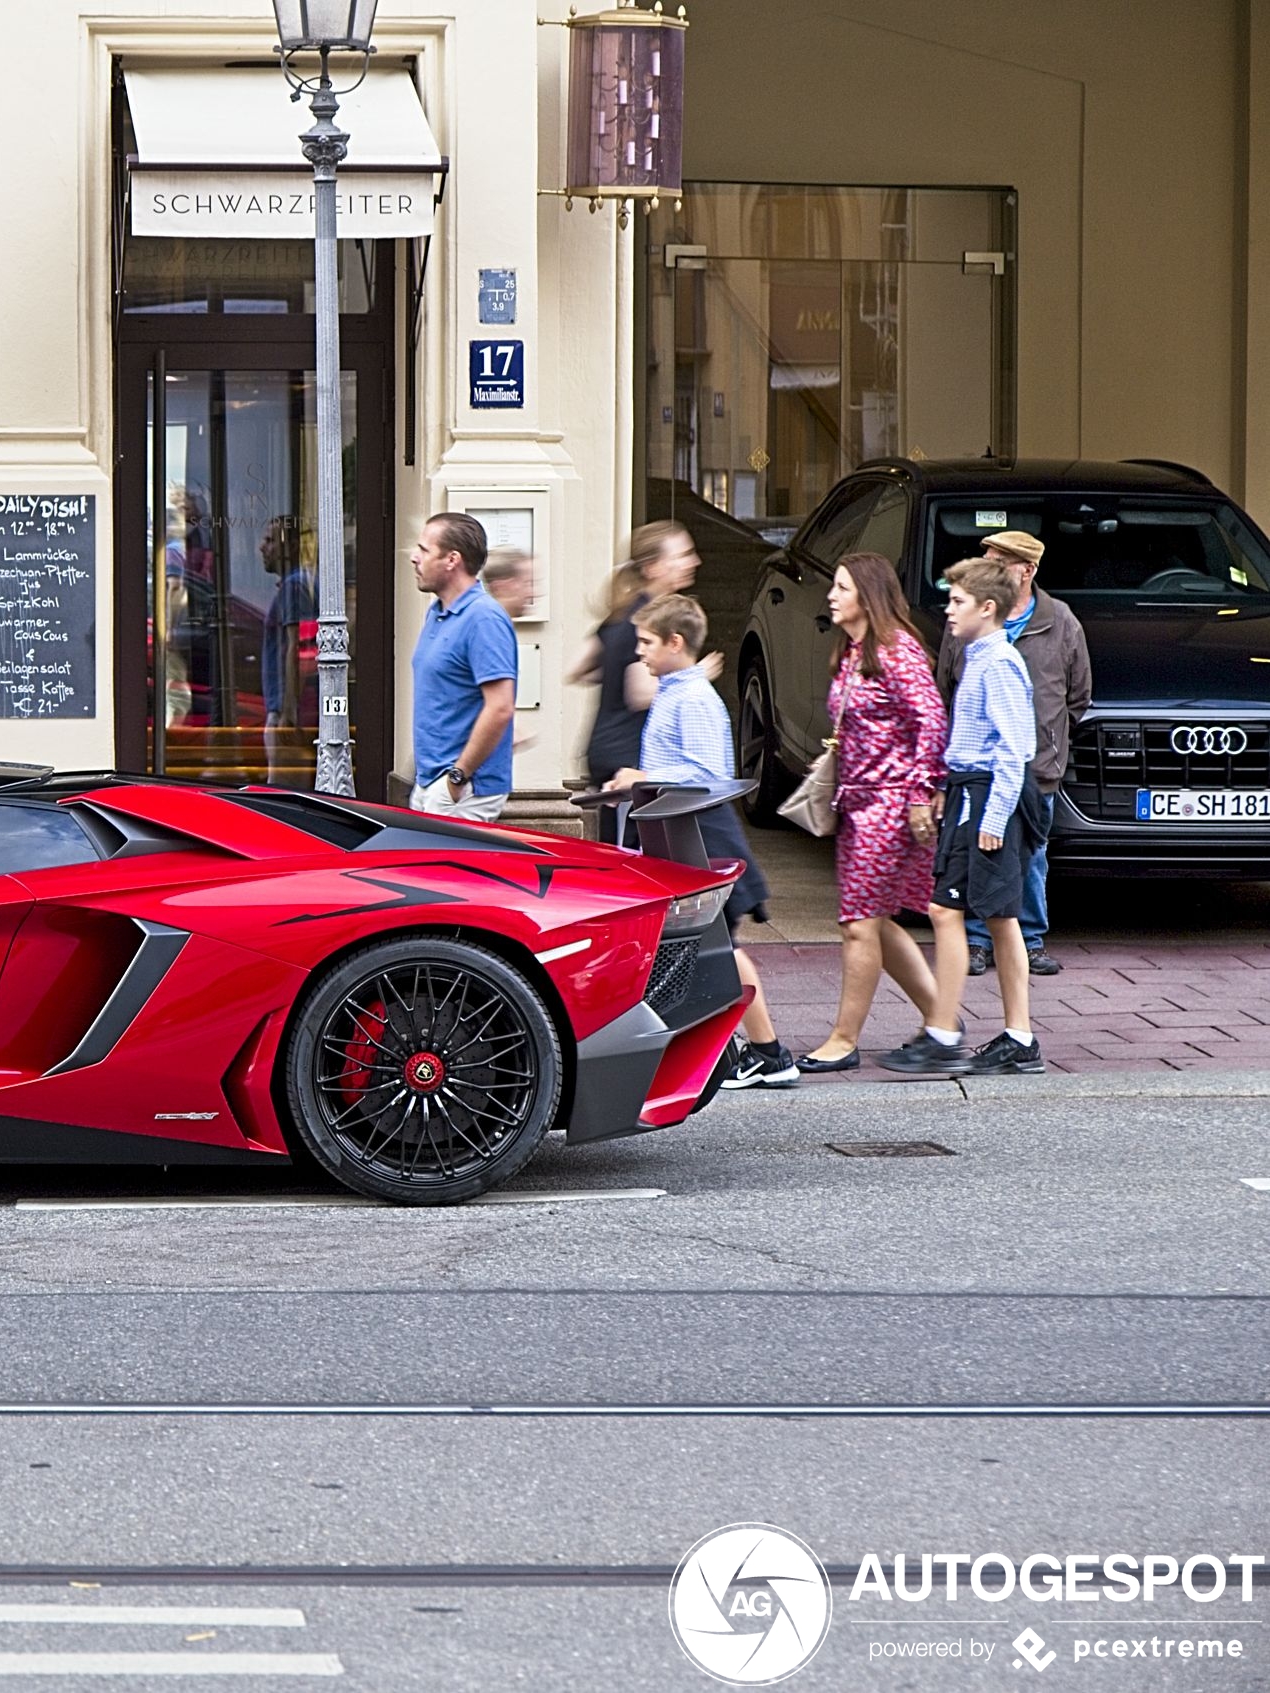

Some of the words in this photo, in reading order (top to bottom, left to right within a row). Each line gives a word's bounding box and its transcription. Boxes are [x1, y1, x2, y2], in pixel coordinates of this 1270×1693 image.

[505, 280, 515, 289] 25
[479, 345, 515, 377] 17
[473, 387, 521, 402] Maximilianstr.
[67, 523, 76, 535] h
[3, 547, 79, 562] Lammrücken
[19, 579, 42, 595] jus
[0, 680, 36, 693] Tasse
[42, 680, 75, 702] Kaffee
[1152, 794, 1180, 816] CE
[1197, 794, 1226, 816] SH
[1231, 794, 1270, 816] 181
